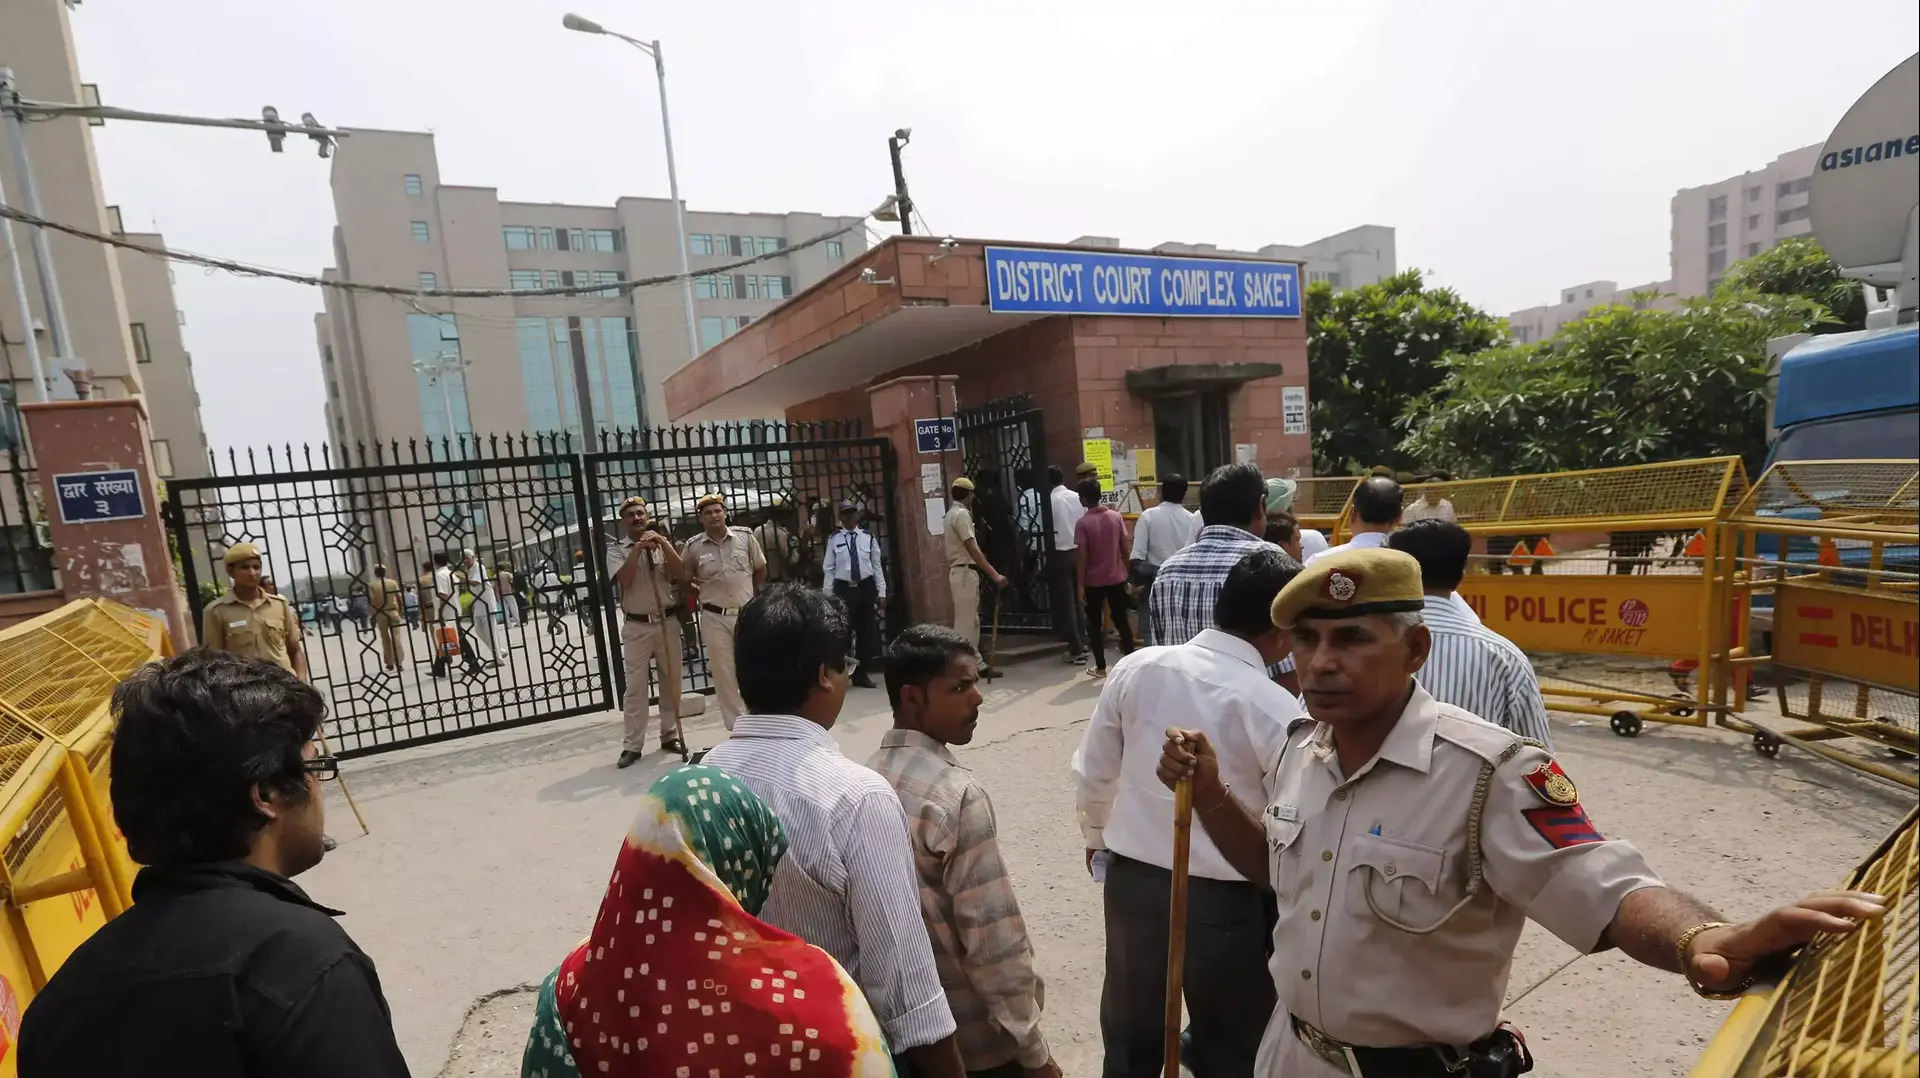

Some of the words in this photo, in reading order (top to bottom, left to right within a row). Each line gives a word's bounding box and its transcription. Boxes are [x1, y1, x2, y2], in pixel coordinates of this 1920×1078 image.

[996, 259, 1083, 303] DISTRICT
[1093, 265, 1152, 304] COURT
[1161, 268, 1237, 307] COMPLEX
[1244, 272, 1292, 307] SAKET
[918, 425, 940, 435] GATE
[934, 437, 941, 448] 3
[60, 482, 89, 499] द्वार
[93, 476, 135, 496] संख्या
[94, 500, 112, 515] ३
[1504, 594, 1607, 625] POLICE
[1599, 627, 1648, 647] SAKET
